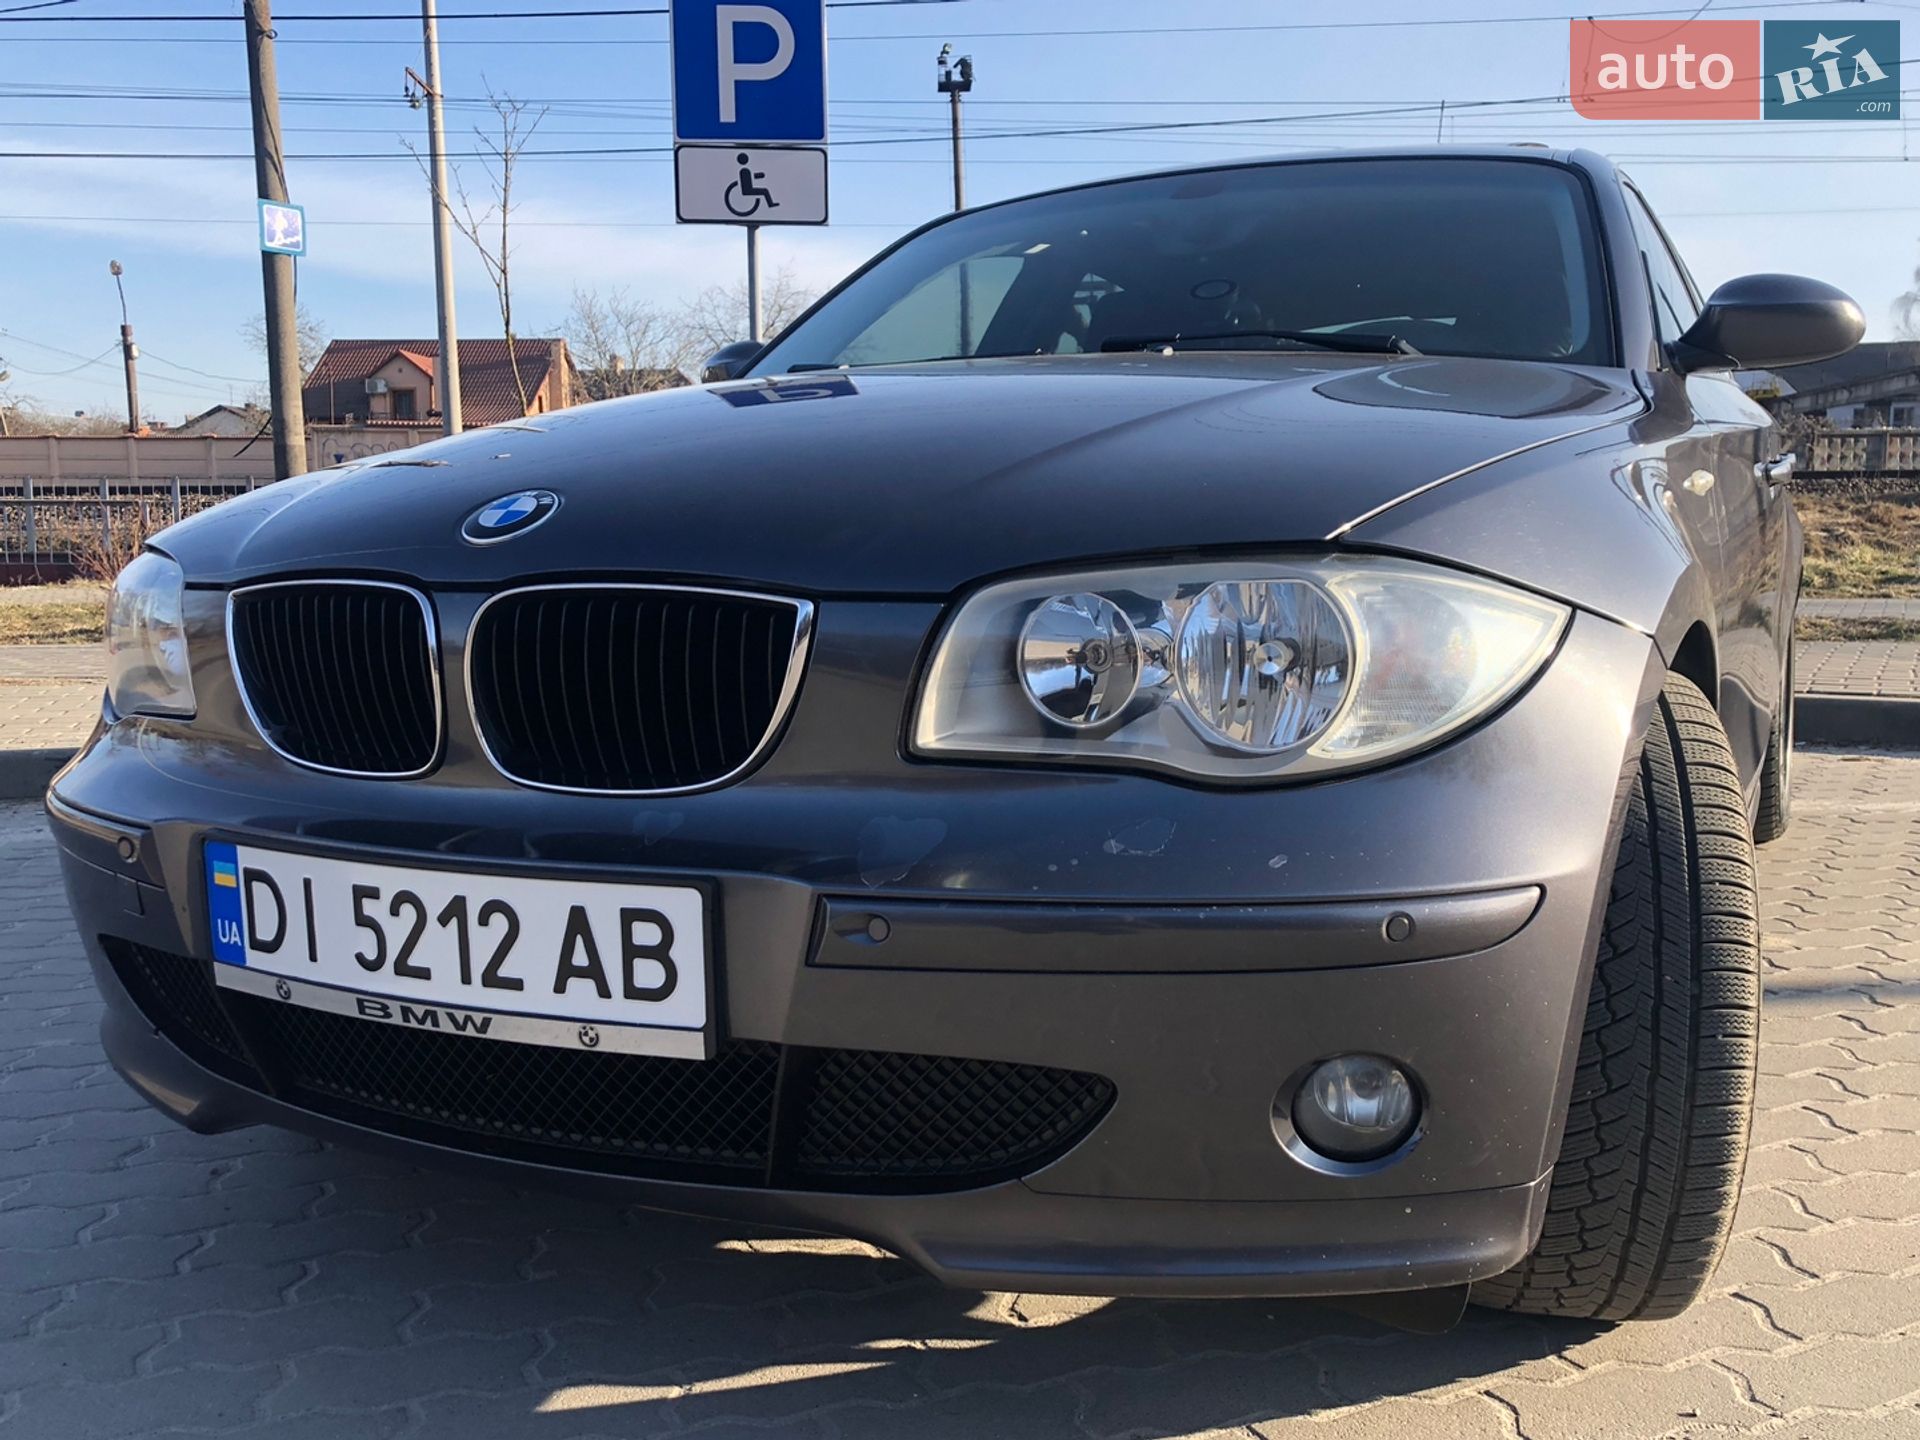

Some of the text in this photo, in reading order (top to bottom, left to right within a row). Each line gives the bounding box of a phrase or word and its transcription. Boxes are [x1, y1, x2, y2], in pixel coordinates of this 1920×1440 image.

[716, 5, 795, 123] P
[217, 918, 242, 946] UA
[243, 866, 679, 1002] DI 5212 AB
[355, 997, 493, 1035] BMW
